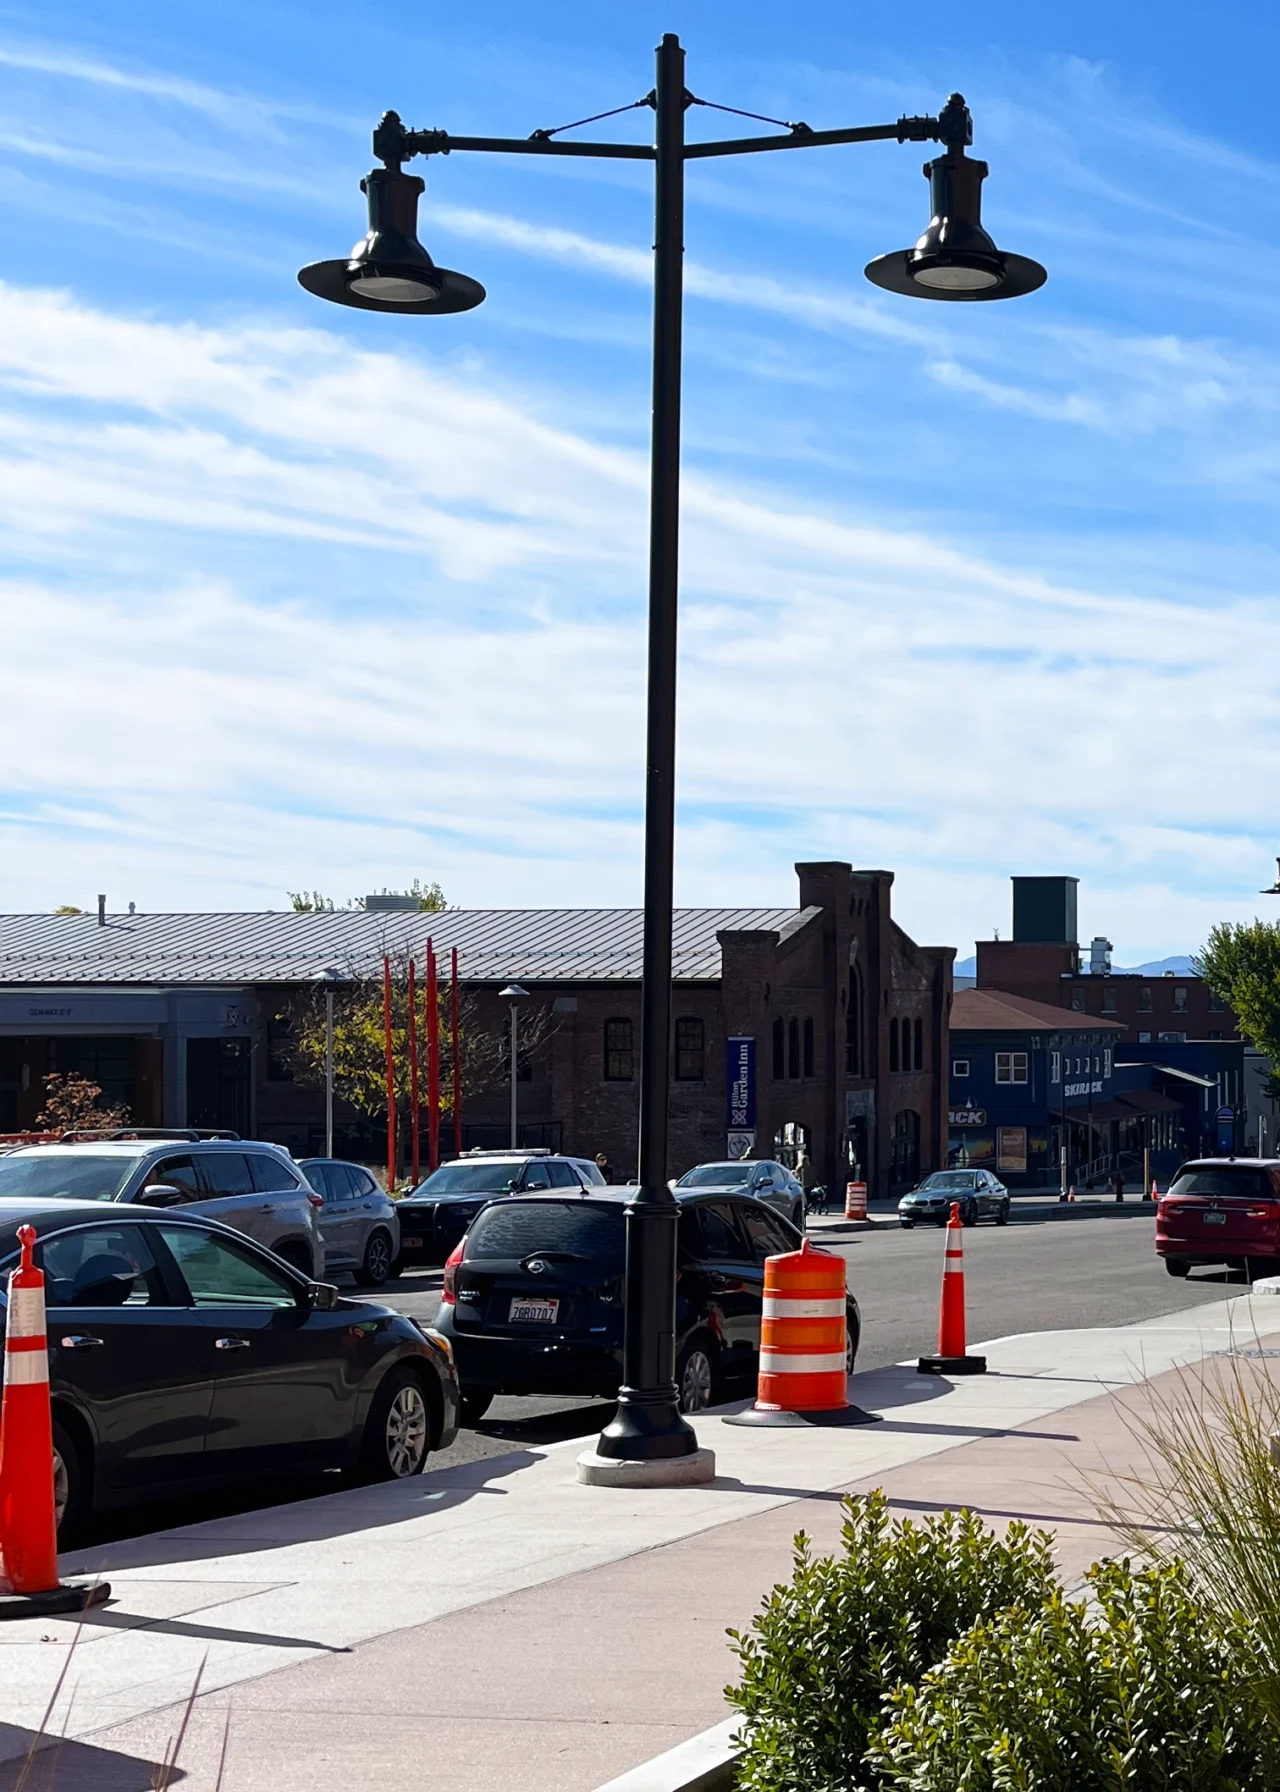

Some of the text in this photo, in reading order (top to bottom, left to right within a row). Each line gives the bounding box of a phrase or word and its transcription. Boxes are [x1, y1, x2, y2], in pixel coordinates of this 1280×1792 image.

[731, 1081, 739, 1108] Hilton
[738, 1044, 748, 1108] Garden Inn
